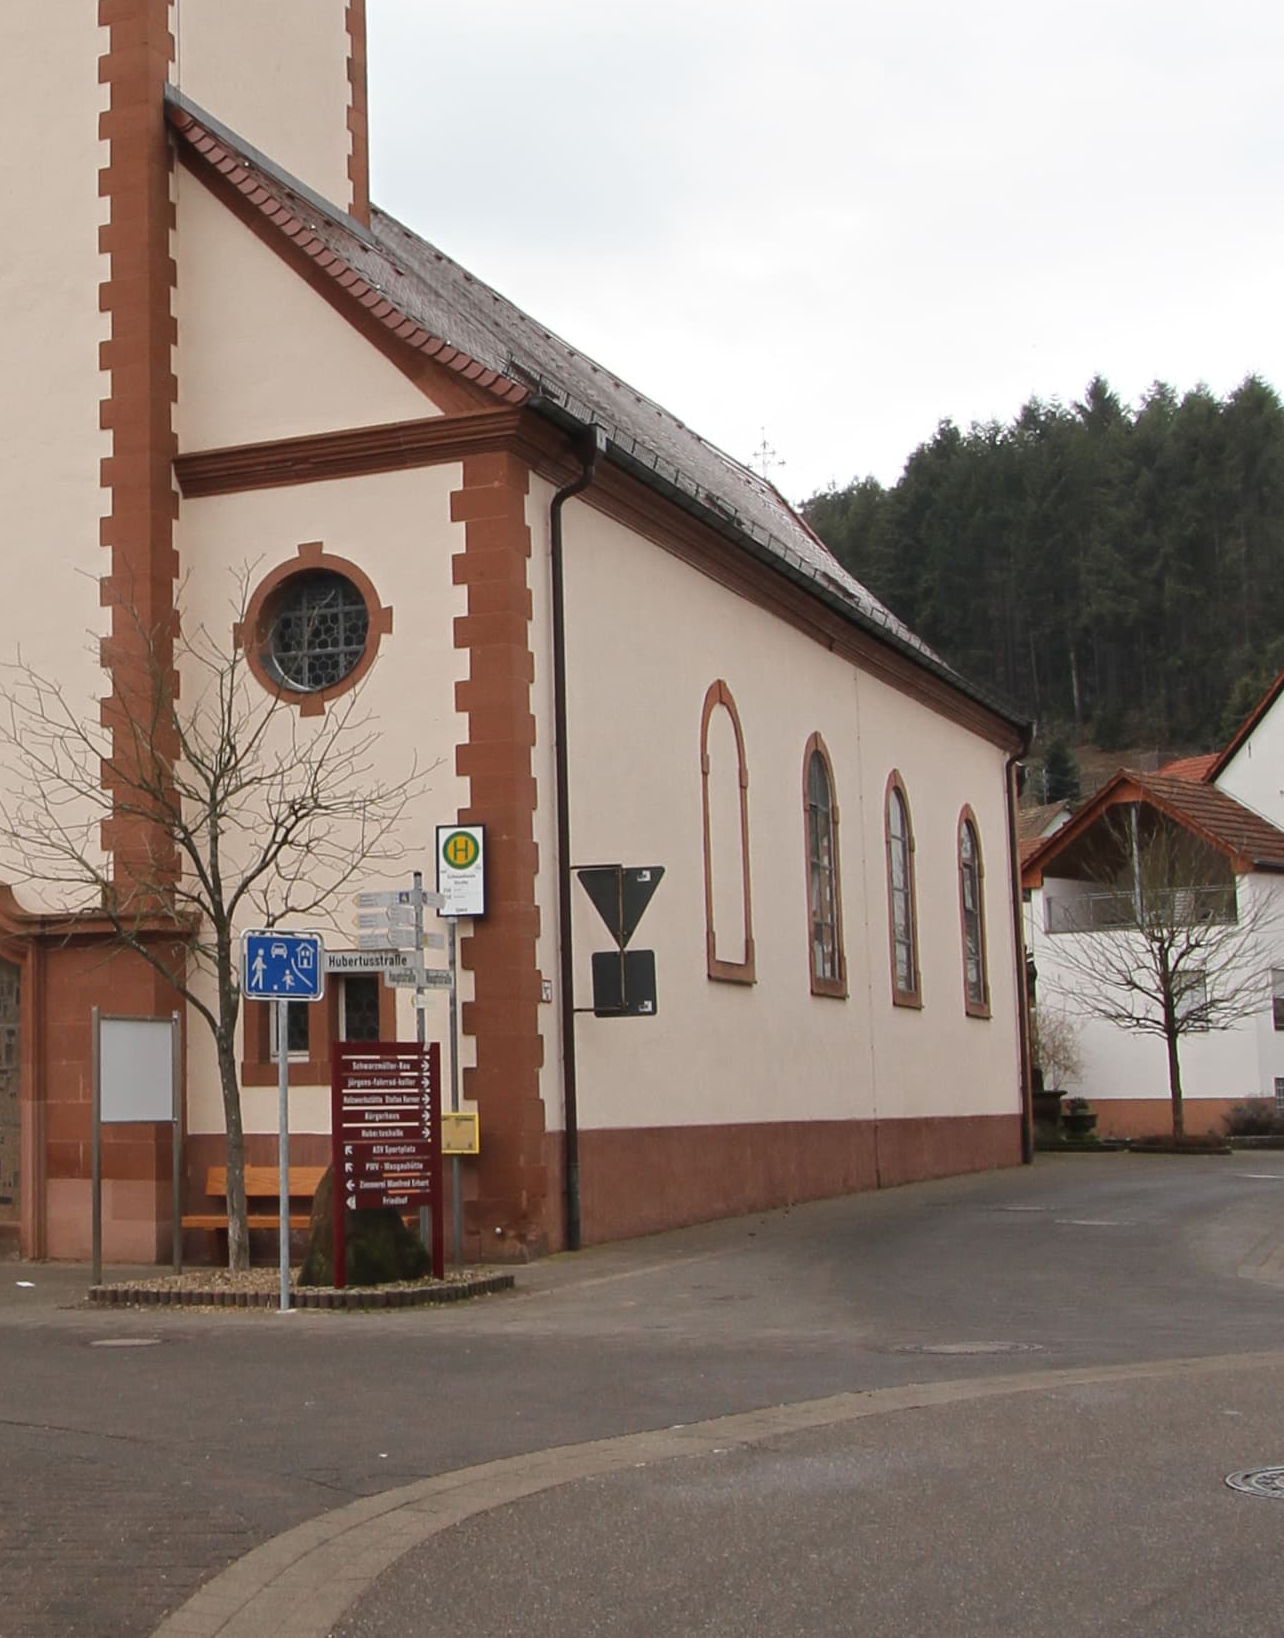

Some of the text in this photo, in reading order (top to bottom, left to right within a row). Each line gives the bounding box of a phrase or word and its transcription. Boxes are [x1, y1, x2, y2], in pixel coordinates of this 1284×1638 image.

[453, 840, 468, 860] H
[328, 954, 407, 968] Hubertusstraße
[382, 1195, 408, 1205] Friedhof
